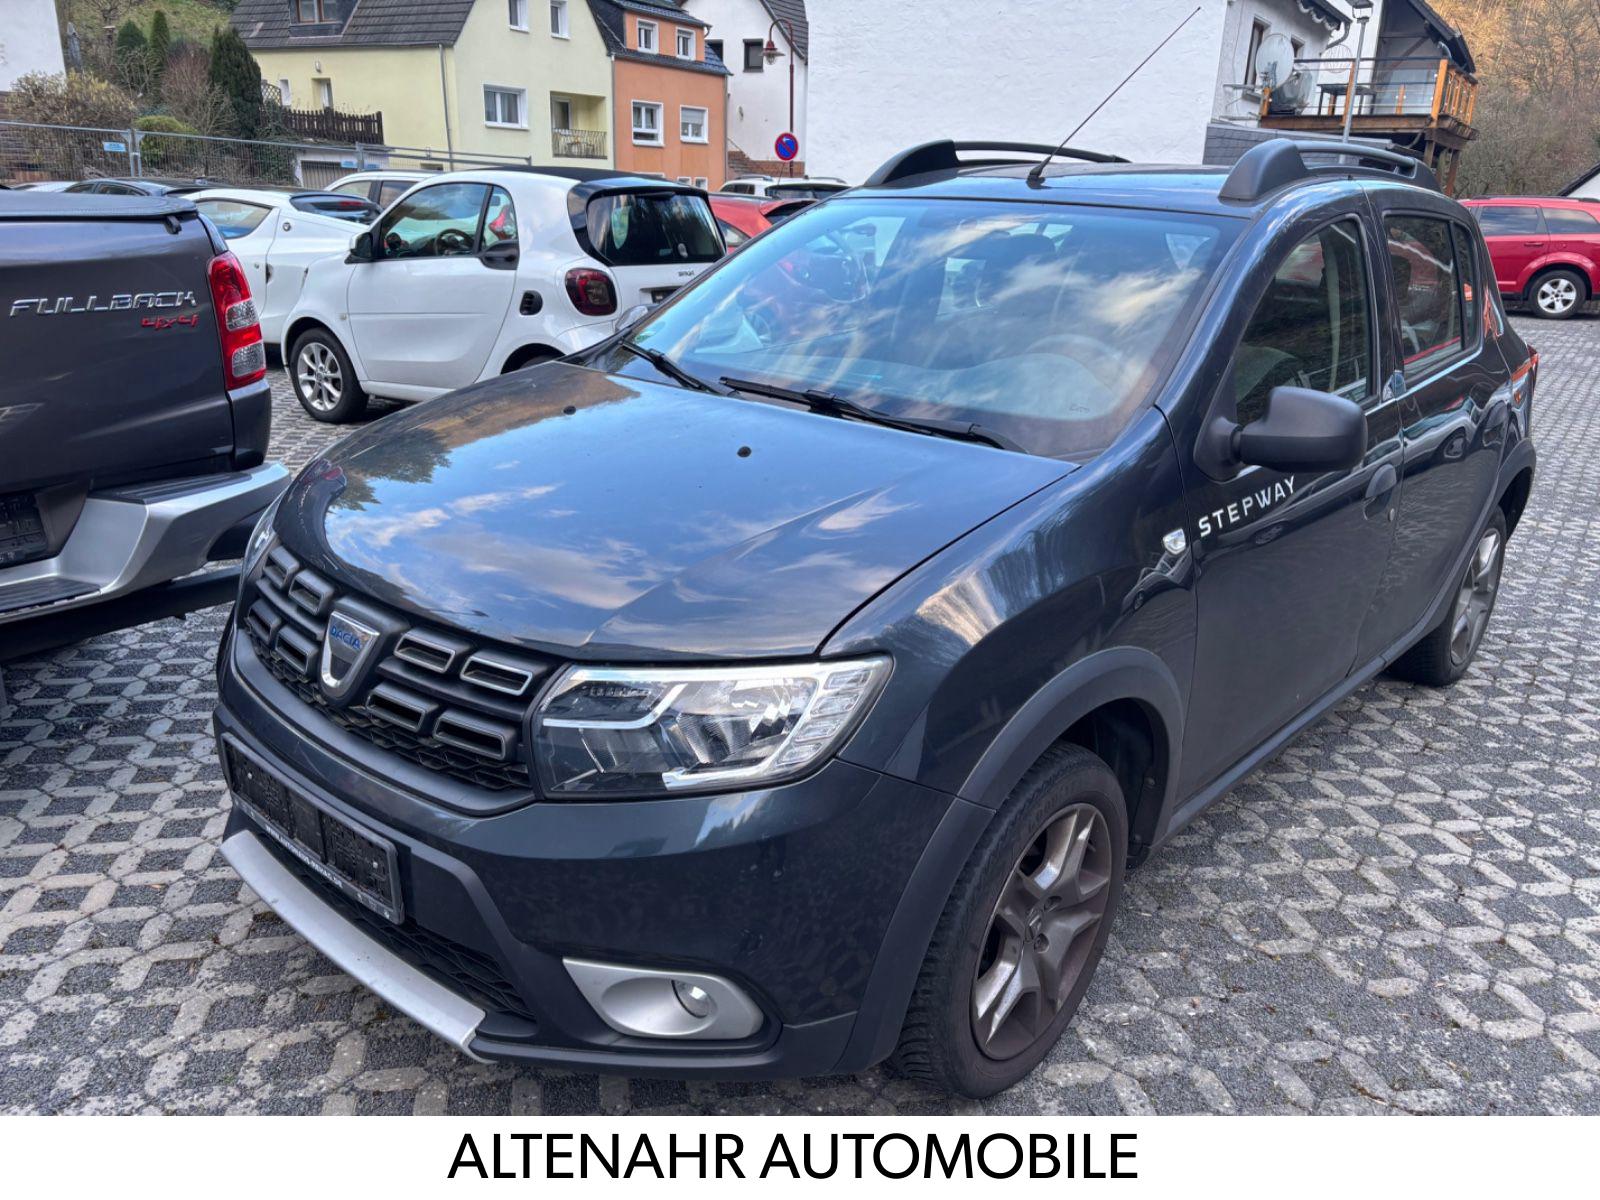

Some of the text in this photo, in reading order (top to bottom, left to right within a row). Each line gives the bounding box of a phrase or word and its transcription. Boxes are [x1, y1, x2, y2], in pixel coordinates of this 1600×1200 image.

[10, 291, 197, 316] FULLBACK
[141, 314, 199, 329] 4x4
[1198, 475, 1295, 538] STEPWAY
[331, 624, 361, 650] DACIA
